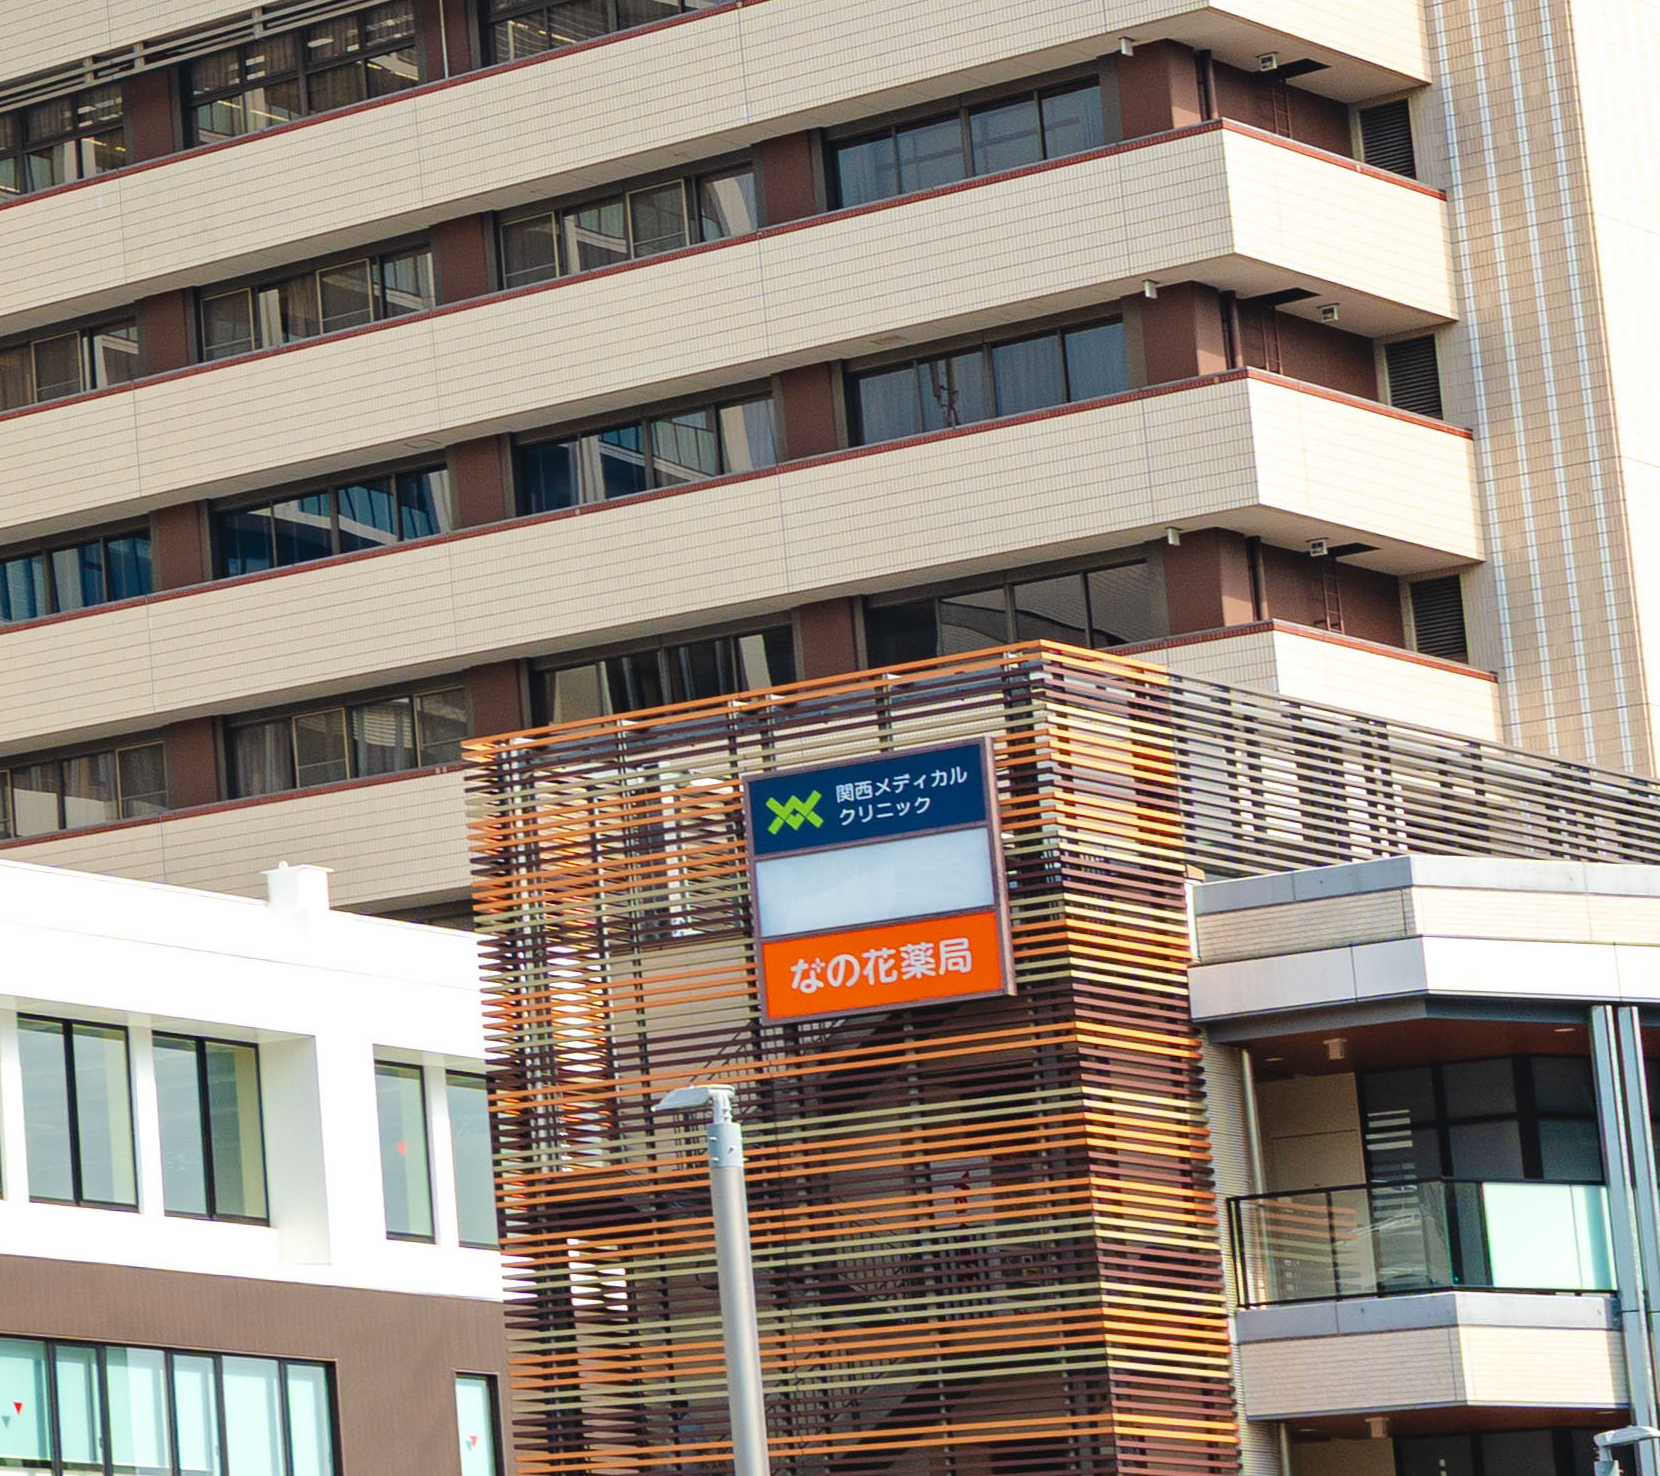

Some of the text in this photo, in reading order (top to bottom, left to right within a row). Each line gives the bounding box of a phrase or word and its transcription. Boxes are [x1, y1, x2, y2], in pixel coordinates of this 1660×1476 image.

[836, 766, 968, 803] 関西メディカル
[839, 797, 931, 826] クリニック
[790, 937, 973, 994] なの花薬局
